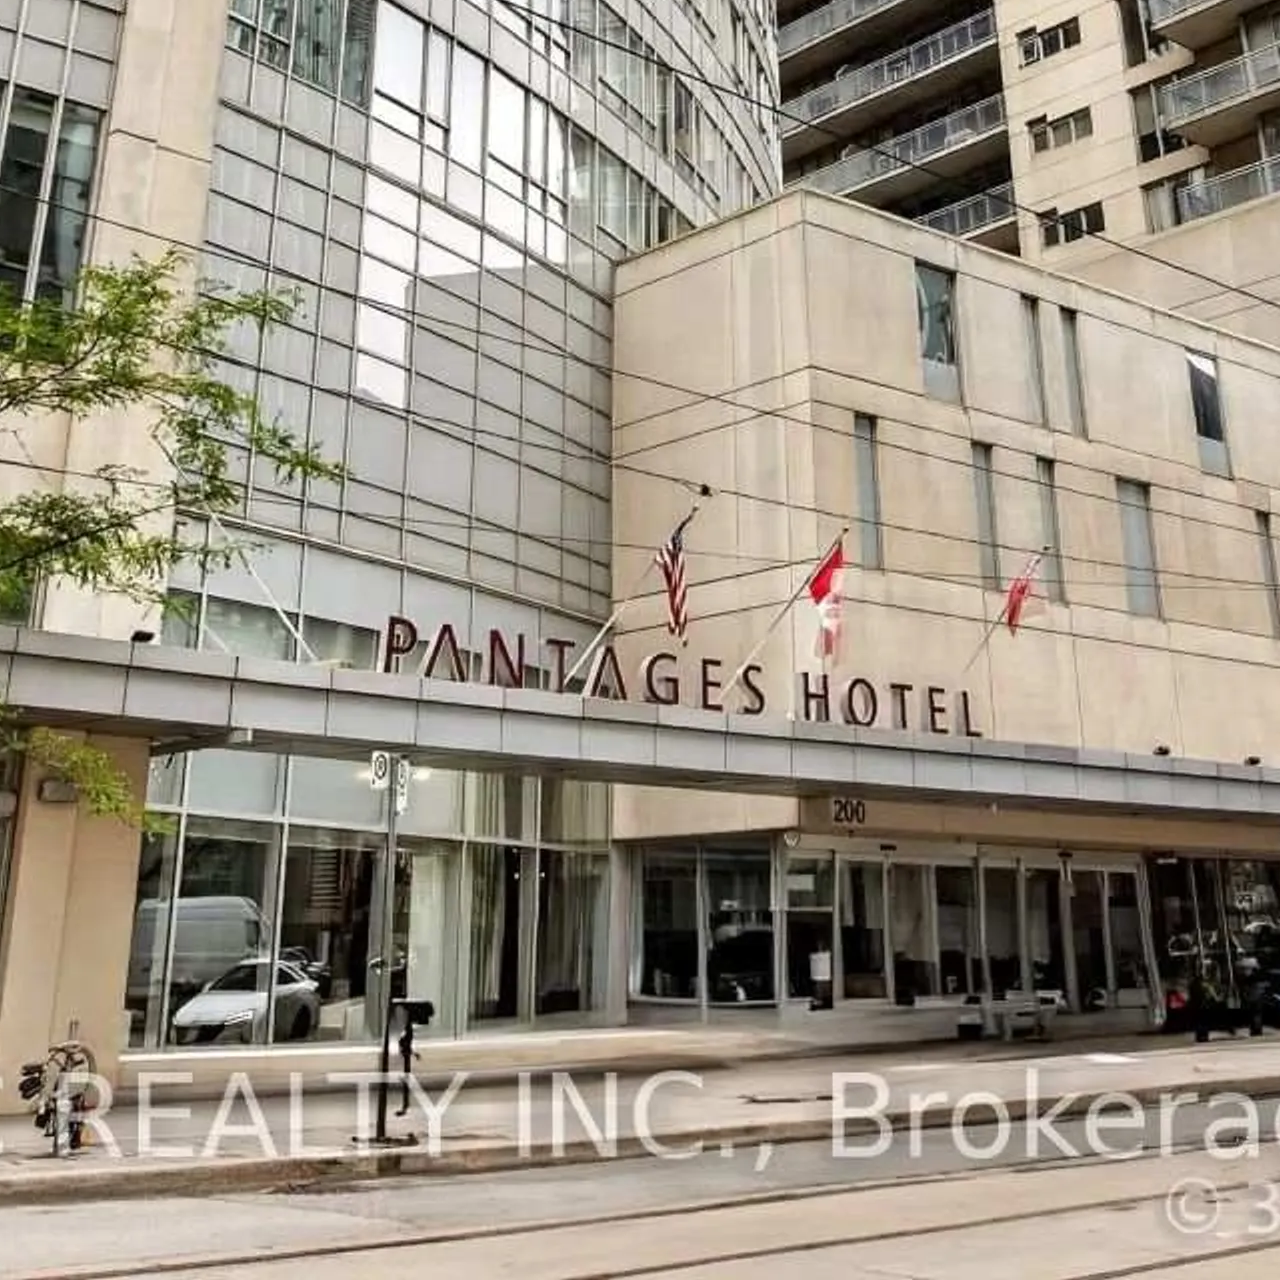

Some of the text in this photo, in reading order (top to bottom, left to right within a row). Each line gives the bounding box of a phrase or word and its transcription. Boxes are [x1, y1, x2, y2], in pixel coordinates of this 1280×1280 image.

[384, 615, 984, 739] PANTAGES HOTEL
[833, 799, 865, 824] 200
